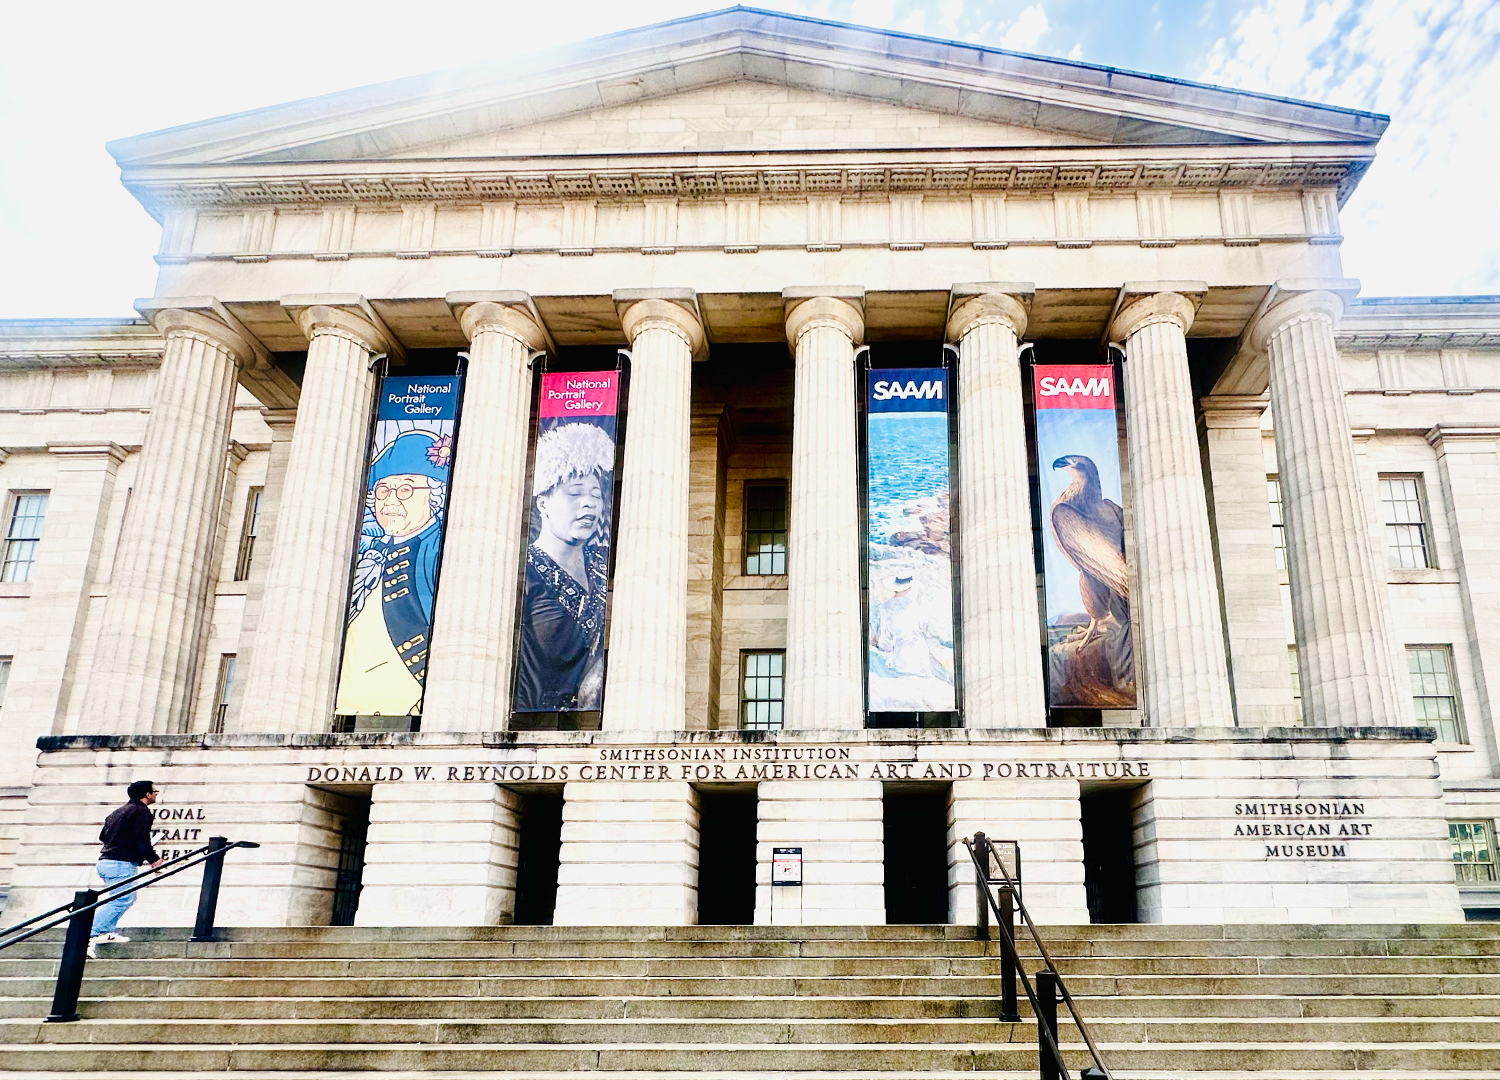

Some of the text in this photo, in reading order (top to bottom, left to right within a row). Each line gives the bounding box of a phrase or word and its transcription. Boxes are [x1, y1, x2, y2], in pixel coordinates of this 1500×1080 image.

[407, 383, 451, 394] National
[566, 378, 611, 390] National
[873, 380, 943, 400] SAAM
[1039, 376, 1110, 397] SAAM
[388, 394, 426, 403] Portrait
[548, 390, 586, 400] Portrait
[404, 404, 442, 415] Gallery
[564, 399, 604, 411] Gallery
[599, 748, 850, 761] SMITHSONIAN INSTITUTION
[306, 762, 1151, 782] DONALD W. REYNOLDS CENTER FOR AMERICAN ART AND PORTRAITURE
[152, 808, 205, 820] IONAL
[1234, 803, 1365, 815] SMITHSONIAN
[151, 828, 202, 840] TRAIT
[1233, 823, 1373, 836] AMERICAN ART
[1265, 845, 1347, 857] MUSEUM
